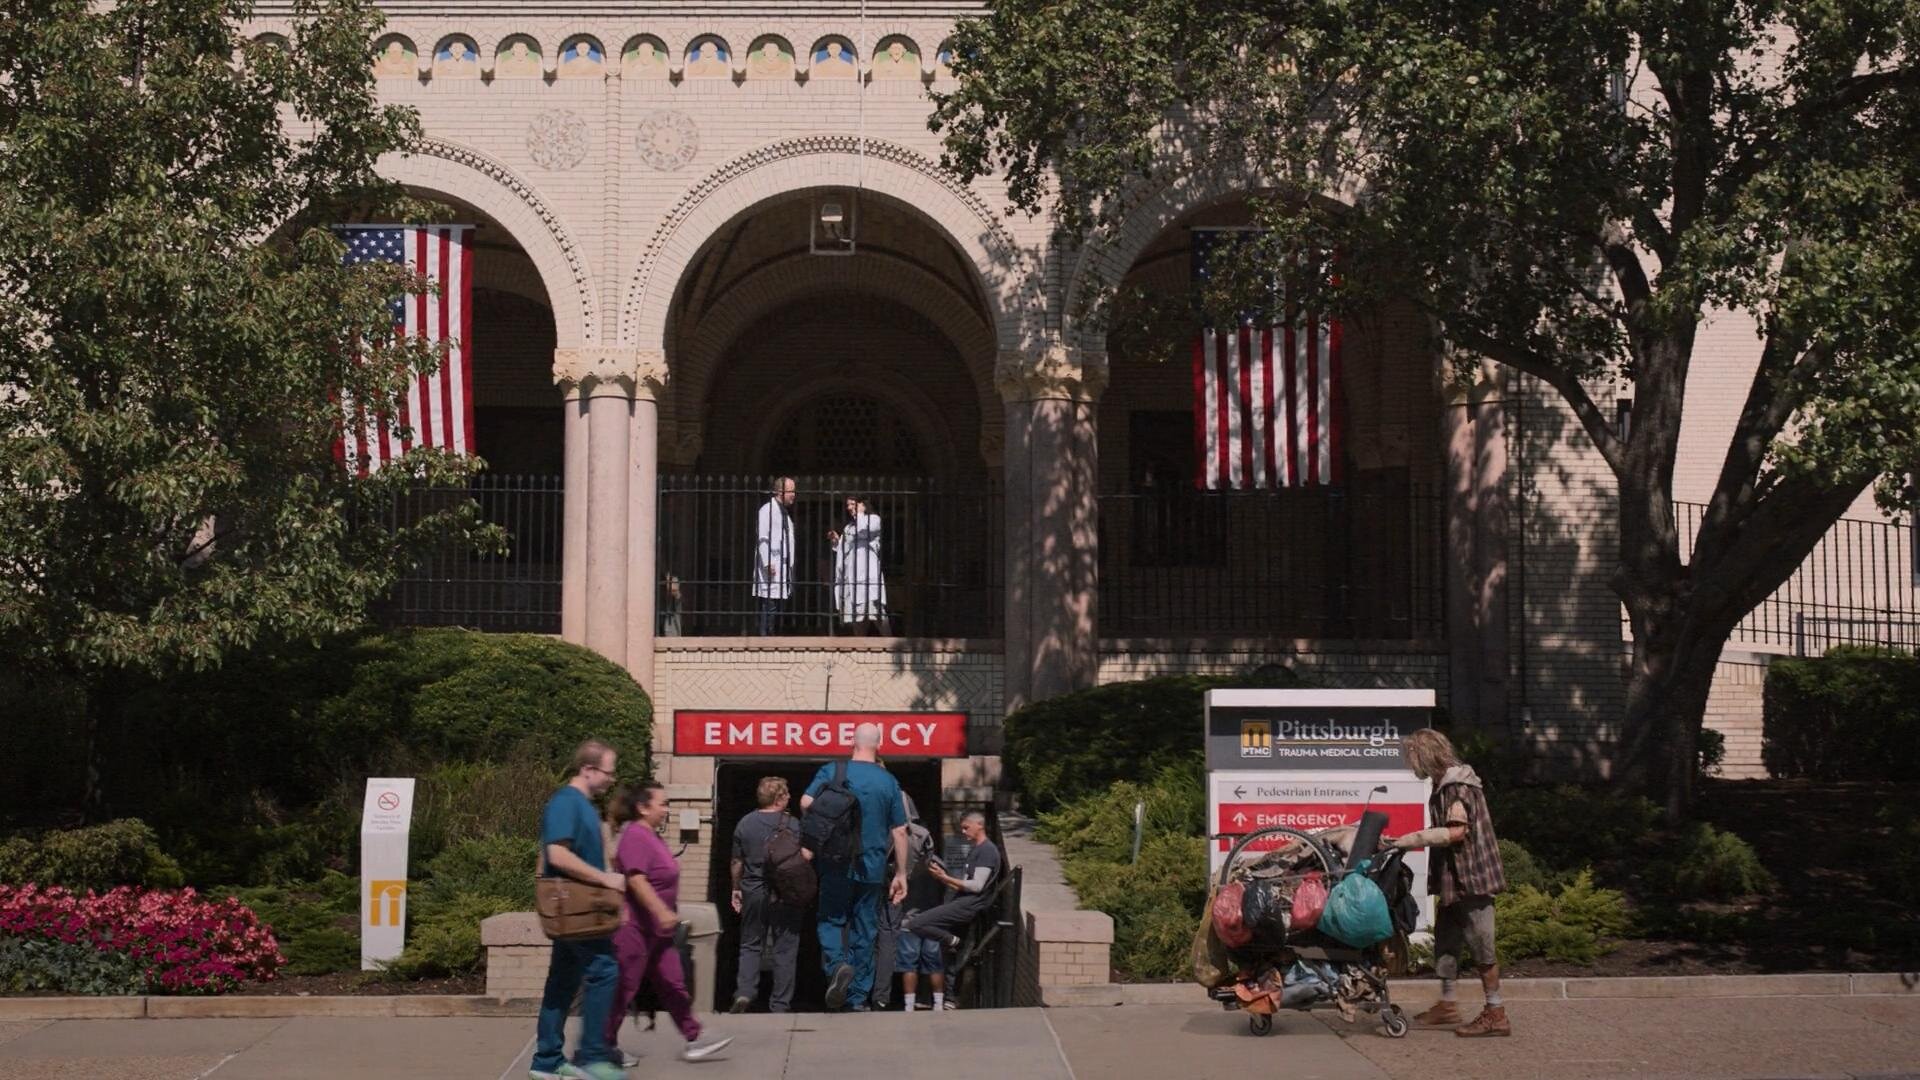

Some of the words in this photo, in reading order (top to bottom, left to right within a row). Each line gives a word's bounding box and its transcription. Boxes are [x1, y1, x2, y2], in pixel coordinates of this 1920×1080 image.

[704, 722, 937, 746] EMERGECY
[1277, 718, 1400, 747] Pittsburgh
[1242, 747, 1270, 756] PTMC
[1279, 748, 1317, 757] TRAUMA
[1320, 748, 1361, 757] MEDICAL
[1363, 748, 1400, 757] CENTER
[1257, 787, 1312, 797] Pedestrian
[1314, 787, 1360, 797] Entrance
[1256, 814, 1347, 825] EMERGENCY
